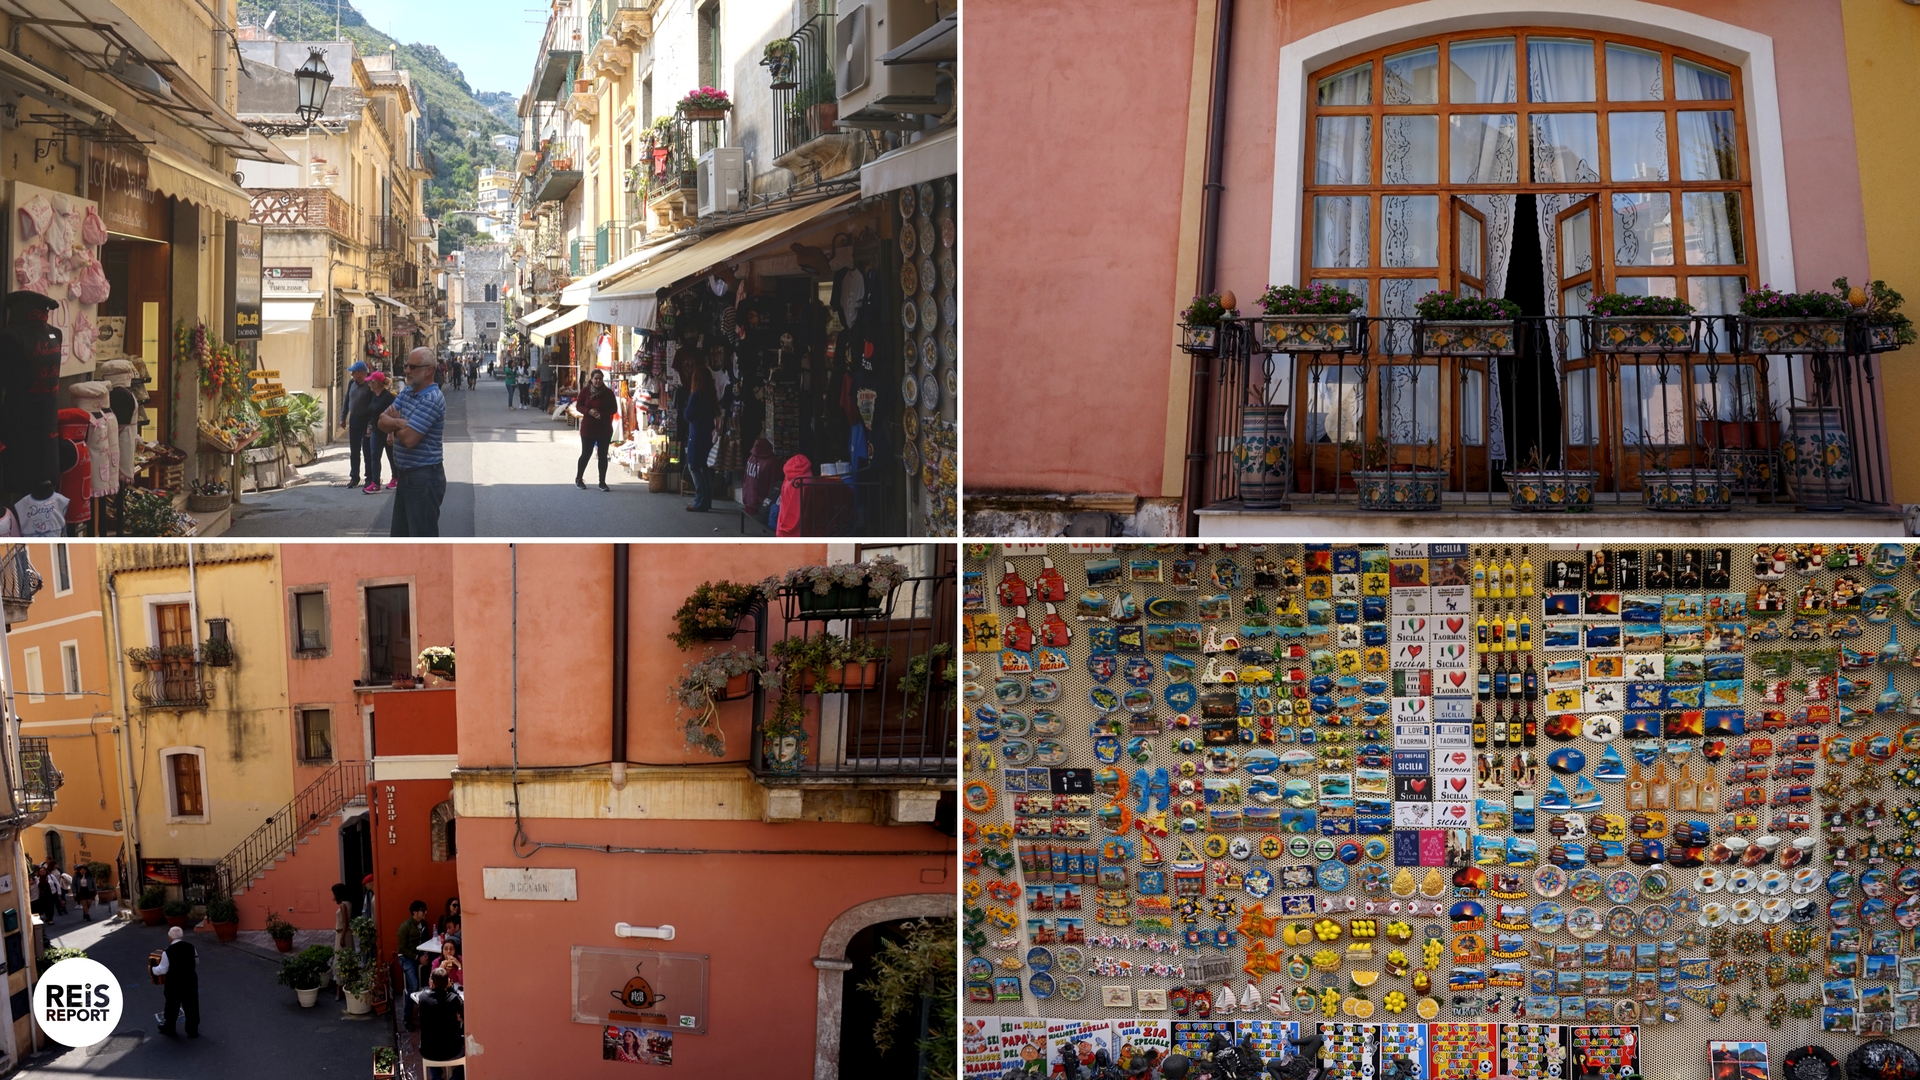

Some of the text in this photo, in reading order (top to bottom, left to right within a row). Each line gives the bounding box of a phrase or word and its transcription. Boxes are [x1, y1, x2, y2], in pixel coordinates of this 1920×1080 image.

[239, 233, 254, 246] Dolce
[242, 247, 259, 260] Salato
[256, 389, 285, 400] TRATTORIA
[1395, 548, 1423, 556] SICILIA
[1435, 544, 1462, 553] SICILIA
[1401, 620, 1405, 630] I
[1440, 620, 1444, 630] I
[1397, 633, 1425, 641] SICILIA
[1400, 647, 1405, 657] I
[1441, 647, 1445, 657] I
[1039, 663, 1066, 671] SICILIA
[1436, 660, 1464, 668] SICILIA
[1443, 674, 1447, 684] I
[1401, 702, 1405, 712] I
[1447, 702, 1450, 710] I
[1398, 714, 1425, 722] SICILIA
[1444, 753, 1449, 763] I
[1404, 781, 1408, 790] I
[1444, 780, 1448, 789] I
[1400, 792, 1427, 800] SICILIA
[1442, 806, 1448, 816] I
[1494, 874, 1499, 890] I
[509, 882, 551, 893] DI GIOVANNI
[1453, 888, 1486, 898] SICILIA
[1490, 889, 1529, 899] TAORMINA
[1496, 904, 1502, 920] I
[1452, 920, 1485, 932] SICILIA
[1492, 919, 1530, 931] TAORMINA
[1494, 934, 1499, 950] I
[1454, 951, 1486, 964] SICILIA
[1491, 949, 1529, 959] TAORMINA
[1449, 982, 1485, 991] Taormina
[1488, 977, 1523, 988] Taormina
[1001, 1023, 1013, 1033] SEI
[1023, 1020, 1047, 1029] MIGLI
[1048, 1024, 1064, 1033] QUI
[1065, 1022, 1081, 1030] VIVE
[1117, 1020, 1135, 1029] QUI
[1175, 1023, 1226, 1031] QUI VIVE UN
[1253, 1023, 1274, 1031] VIVE
[1275, 1023, 1287, 1031] UN
[1336, 1025, 1356, 1033] VIVE
[1357, 1025, 1376, 1034] UNO
[1503, 1025, 1557, 1034] QUI VIVE UN
[1048, 1022, 1110, 1040] MIGLIORE SORELLA
[1122, 1027, 1167, 1038] UNA ZIA
[1574, 1028, 1627, 1037] QUI VIVE UN
[987, 1035, 999, 1045] SEI
[1001, 1033, 1030, 1048] PAPA'
[1070, 1032, 1093, 1042] MONDO
[1501, 1034, 1545, 1044] PALERMITANO
[1133, 1038, 1170, 1048] SPECIALE
[1252, 1042, 1283, 1050] EMPRE
[1573, 1038, 1625, 1047] MILANISTA
[1329, 1045, 1364, 1053] SEMPRE
[1433, 1044, 1470, 1052] SEMPRE
[1510, 1045, 1543, 1053] SEMPRE
[1586, 1048, 1623, 1057] SEMPRE
[966, 1053, 1001, 1063] MIGLIORE
[1003, 1049, 1019, 1059] DEL
[1331, 1053, 1362, 1061] FEDELE
[966, 1061, 1001, 1073] MAMMA
[1001, 1059, 1024, 1070] MONDO
[1332, 1062, 1355, 1070] ALLA
[1507, 1069, 1549, 1077] SQUADRA
